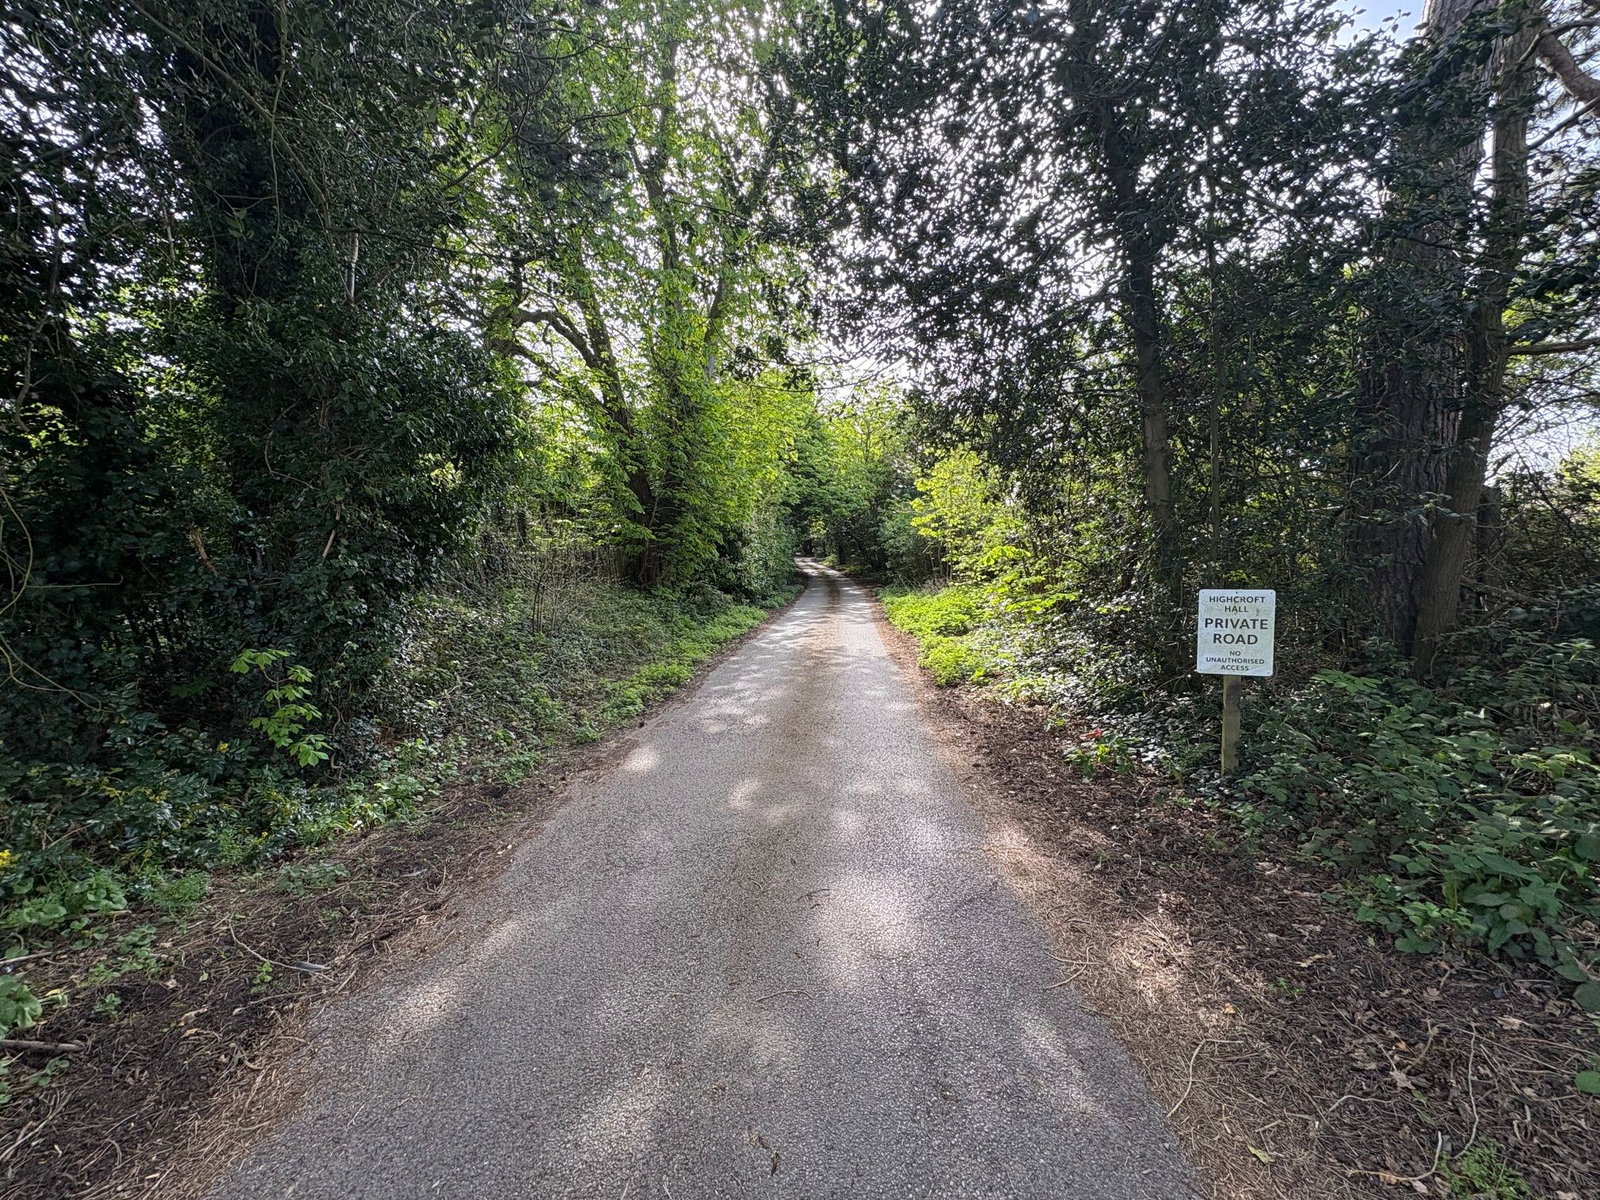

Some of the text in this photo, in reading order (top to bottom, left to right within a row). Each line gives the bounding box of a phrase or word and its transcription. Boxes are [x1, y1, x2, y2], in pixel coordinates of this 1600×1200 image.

[1209, 596, 1266, 604] HIGHCROFT
[1204, 618, 1268, 630] PRIVATE
[1213, 634, 1258, 645] ROAD
[1206, 656, 1265, 664] UNAUTHORISED
